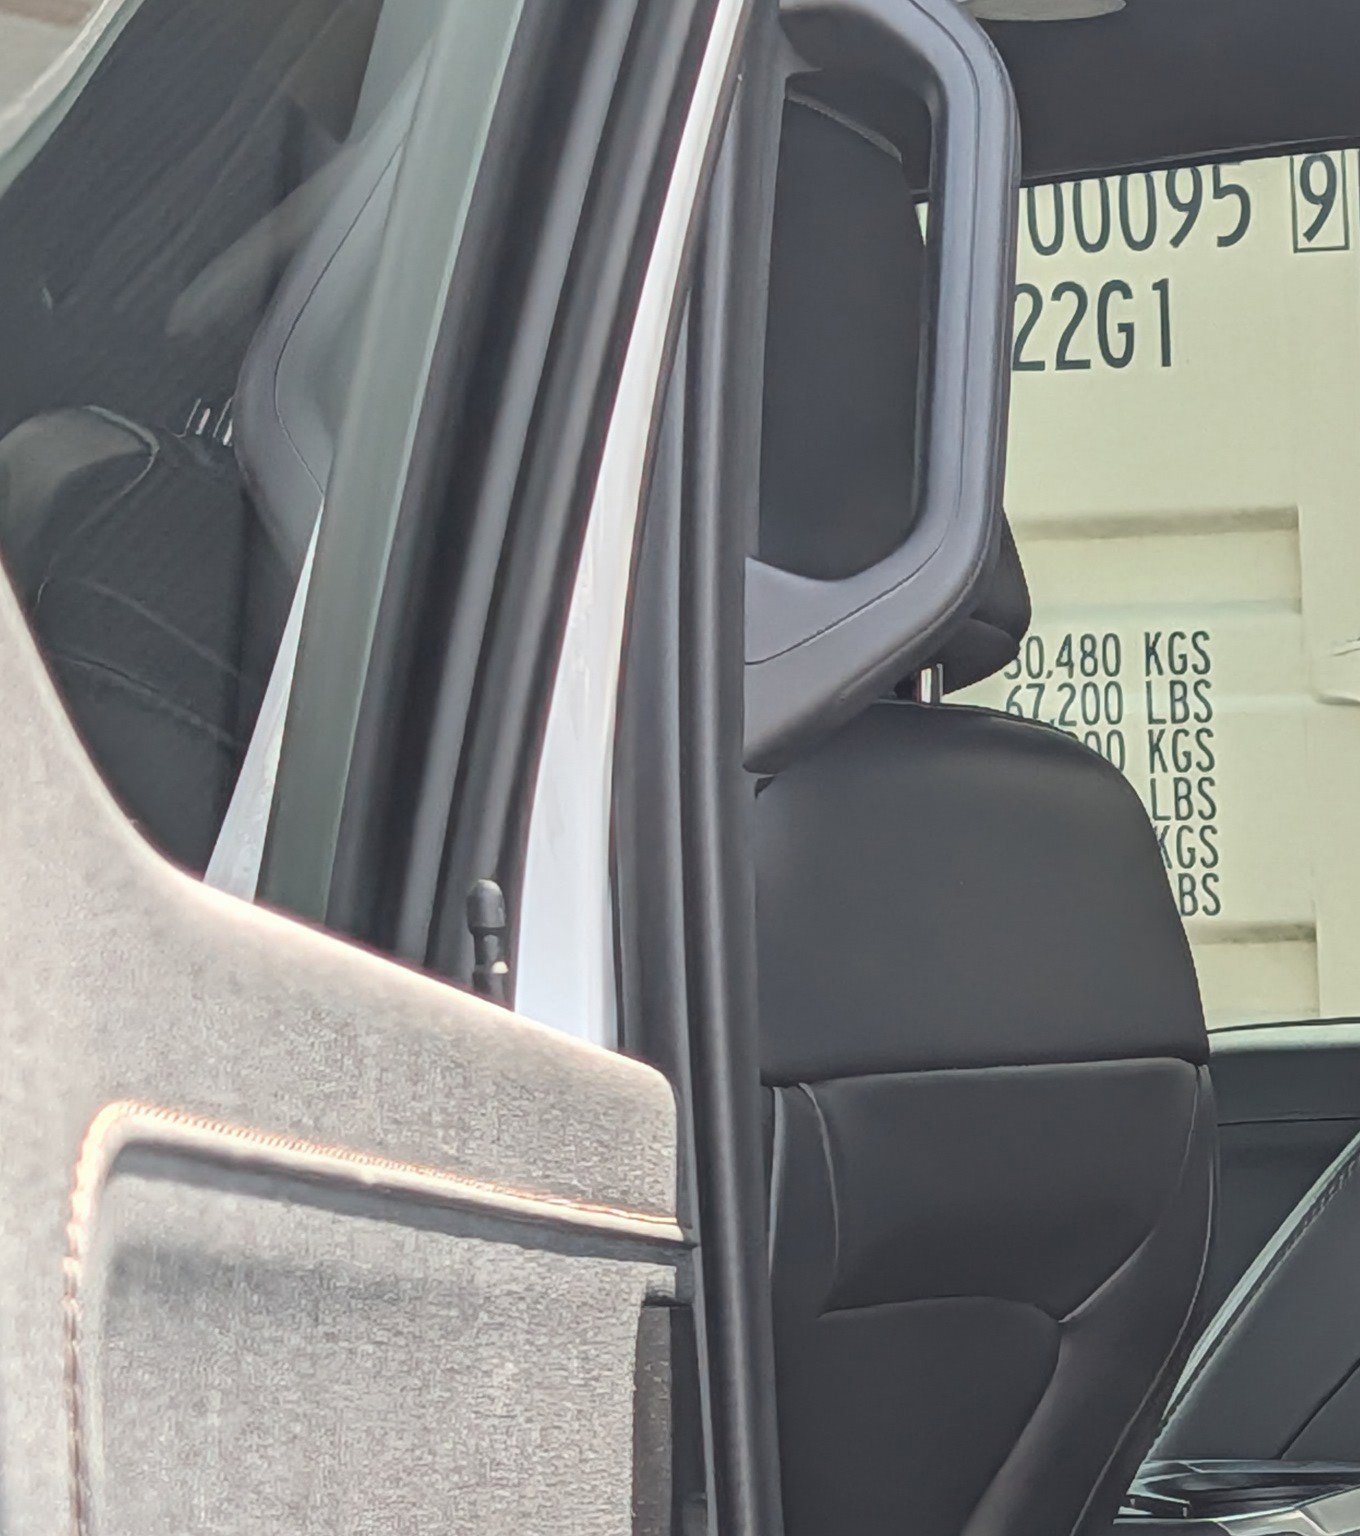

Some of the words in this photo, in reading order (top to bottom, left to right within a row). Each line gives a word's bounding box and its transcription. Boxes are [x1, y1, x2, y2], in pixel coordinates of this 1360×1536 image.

[1299, 153, 1337, 243] 9
[1013, 278, 1171, 371] 22G1
[1144, 631, 1211, 676] KGS
[1146, 679, 1213, 724] LBS
[1148, 728, 1215, 773] KGS
[1150, 777, 1217, 821] LBS
[1179, 873, 1221, 916] BS
